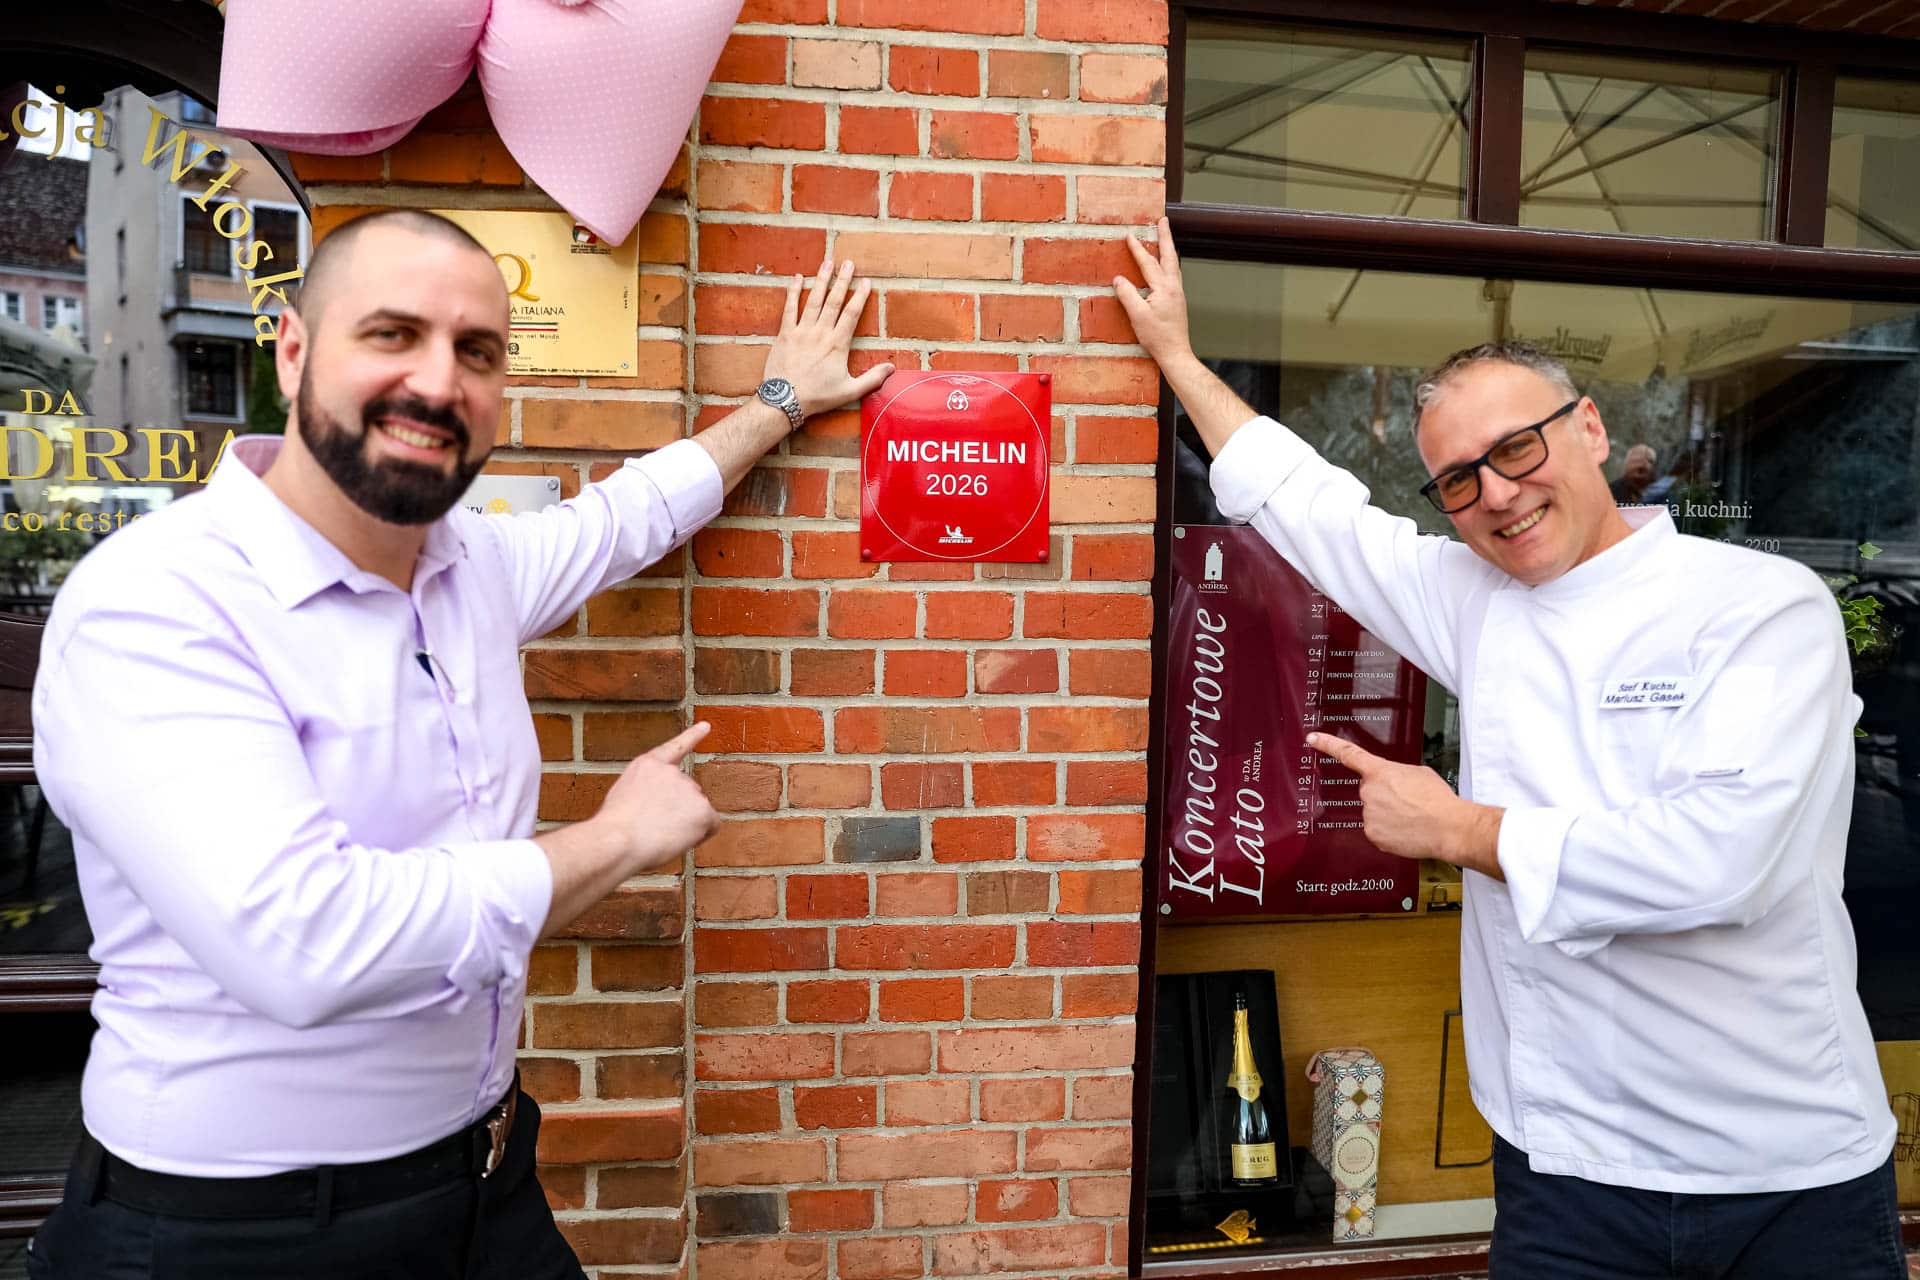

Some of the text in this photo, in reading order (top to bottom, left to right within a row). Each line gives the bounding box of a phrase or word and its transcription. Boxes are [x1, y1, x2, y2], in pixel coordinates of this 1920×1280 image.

[141, 105, 305, 347] Włoska
[521, 306, 565, 316] ITALIANA
[20, 389, 84, 415] DA
[887, 440, 1026, 464] MICHELIN
[925, 474, 988, 496] 2026
[1684, 500, 1752, 519] kuchni:
[1311, 604, 1324, 614] 27
[1308, 648, 1322, 658] 04
[1307, 670, 1320, 678] 10
[1307, 692, 1318, 702] 17
[1303, 714, 1316, 724] 24
[1168, 607, 1228, 903] Koncertowe
[1252, 740, 1263, 782] ANDREA
[1242, 758, 1251, 774] DA
[1298, 775, 1312, 785] 08
[1297, 821, 1309, 830] 29
[1219, 787, 1265, 906] Lato
[1296, 878, 1394, 896] Start: godz.20:00
